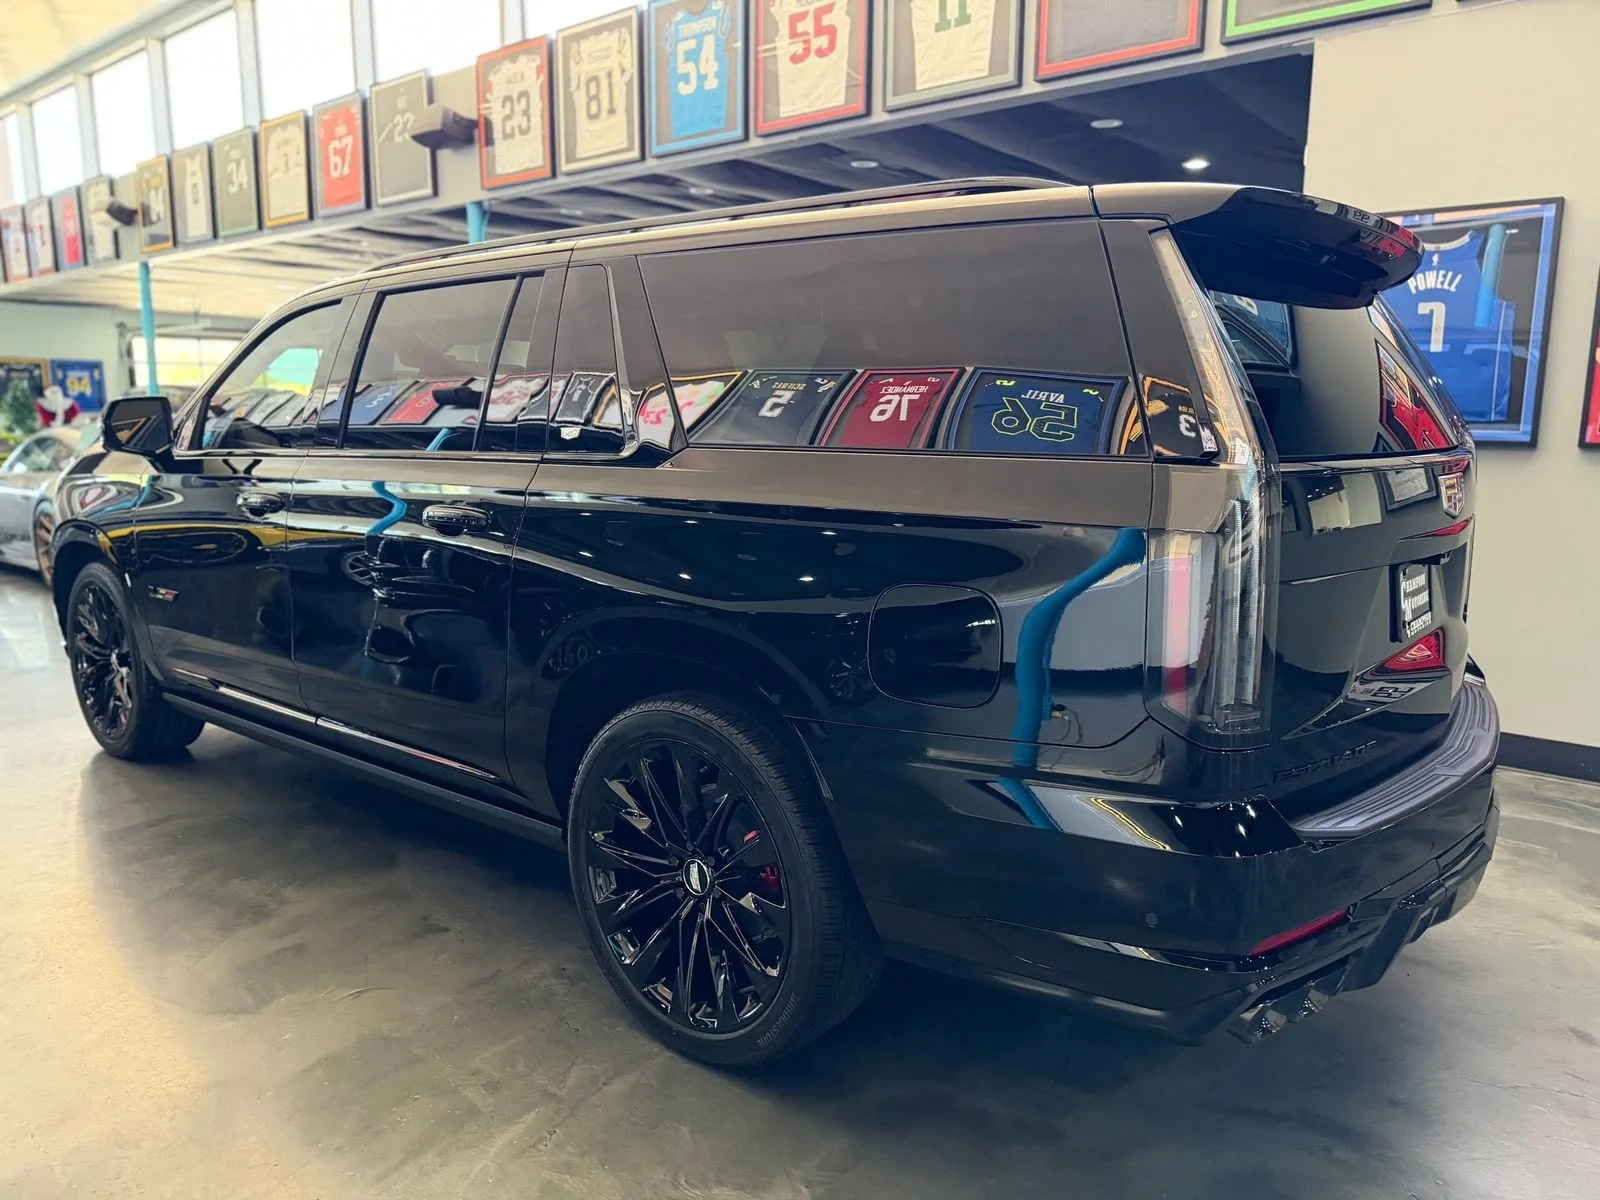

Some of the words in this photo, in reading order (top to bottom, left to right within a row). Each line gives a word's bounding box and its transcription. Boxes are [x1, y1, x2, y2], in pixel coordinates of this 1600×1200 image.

[788, 3, 837, 65] 55
[676, 34, 719, 95] 54
[502, 90, 531, 141] 23
[585, 71, 616, 121] 81
[227, 159, 249, 196] 34
[328, 135, 354, 178] 67
[1407, 269, 1463, 295] POWELL
[1417, 302, 1446, 353] 7
[66, 375, 93, 397] 94
